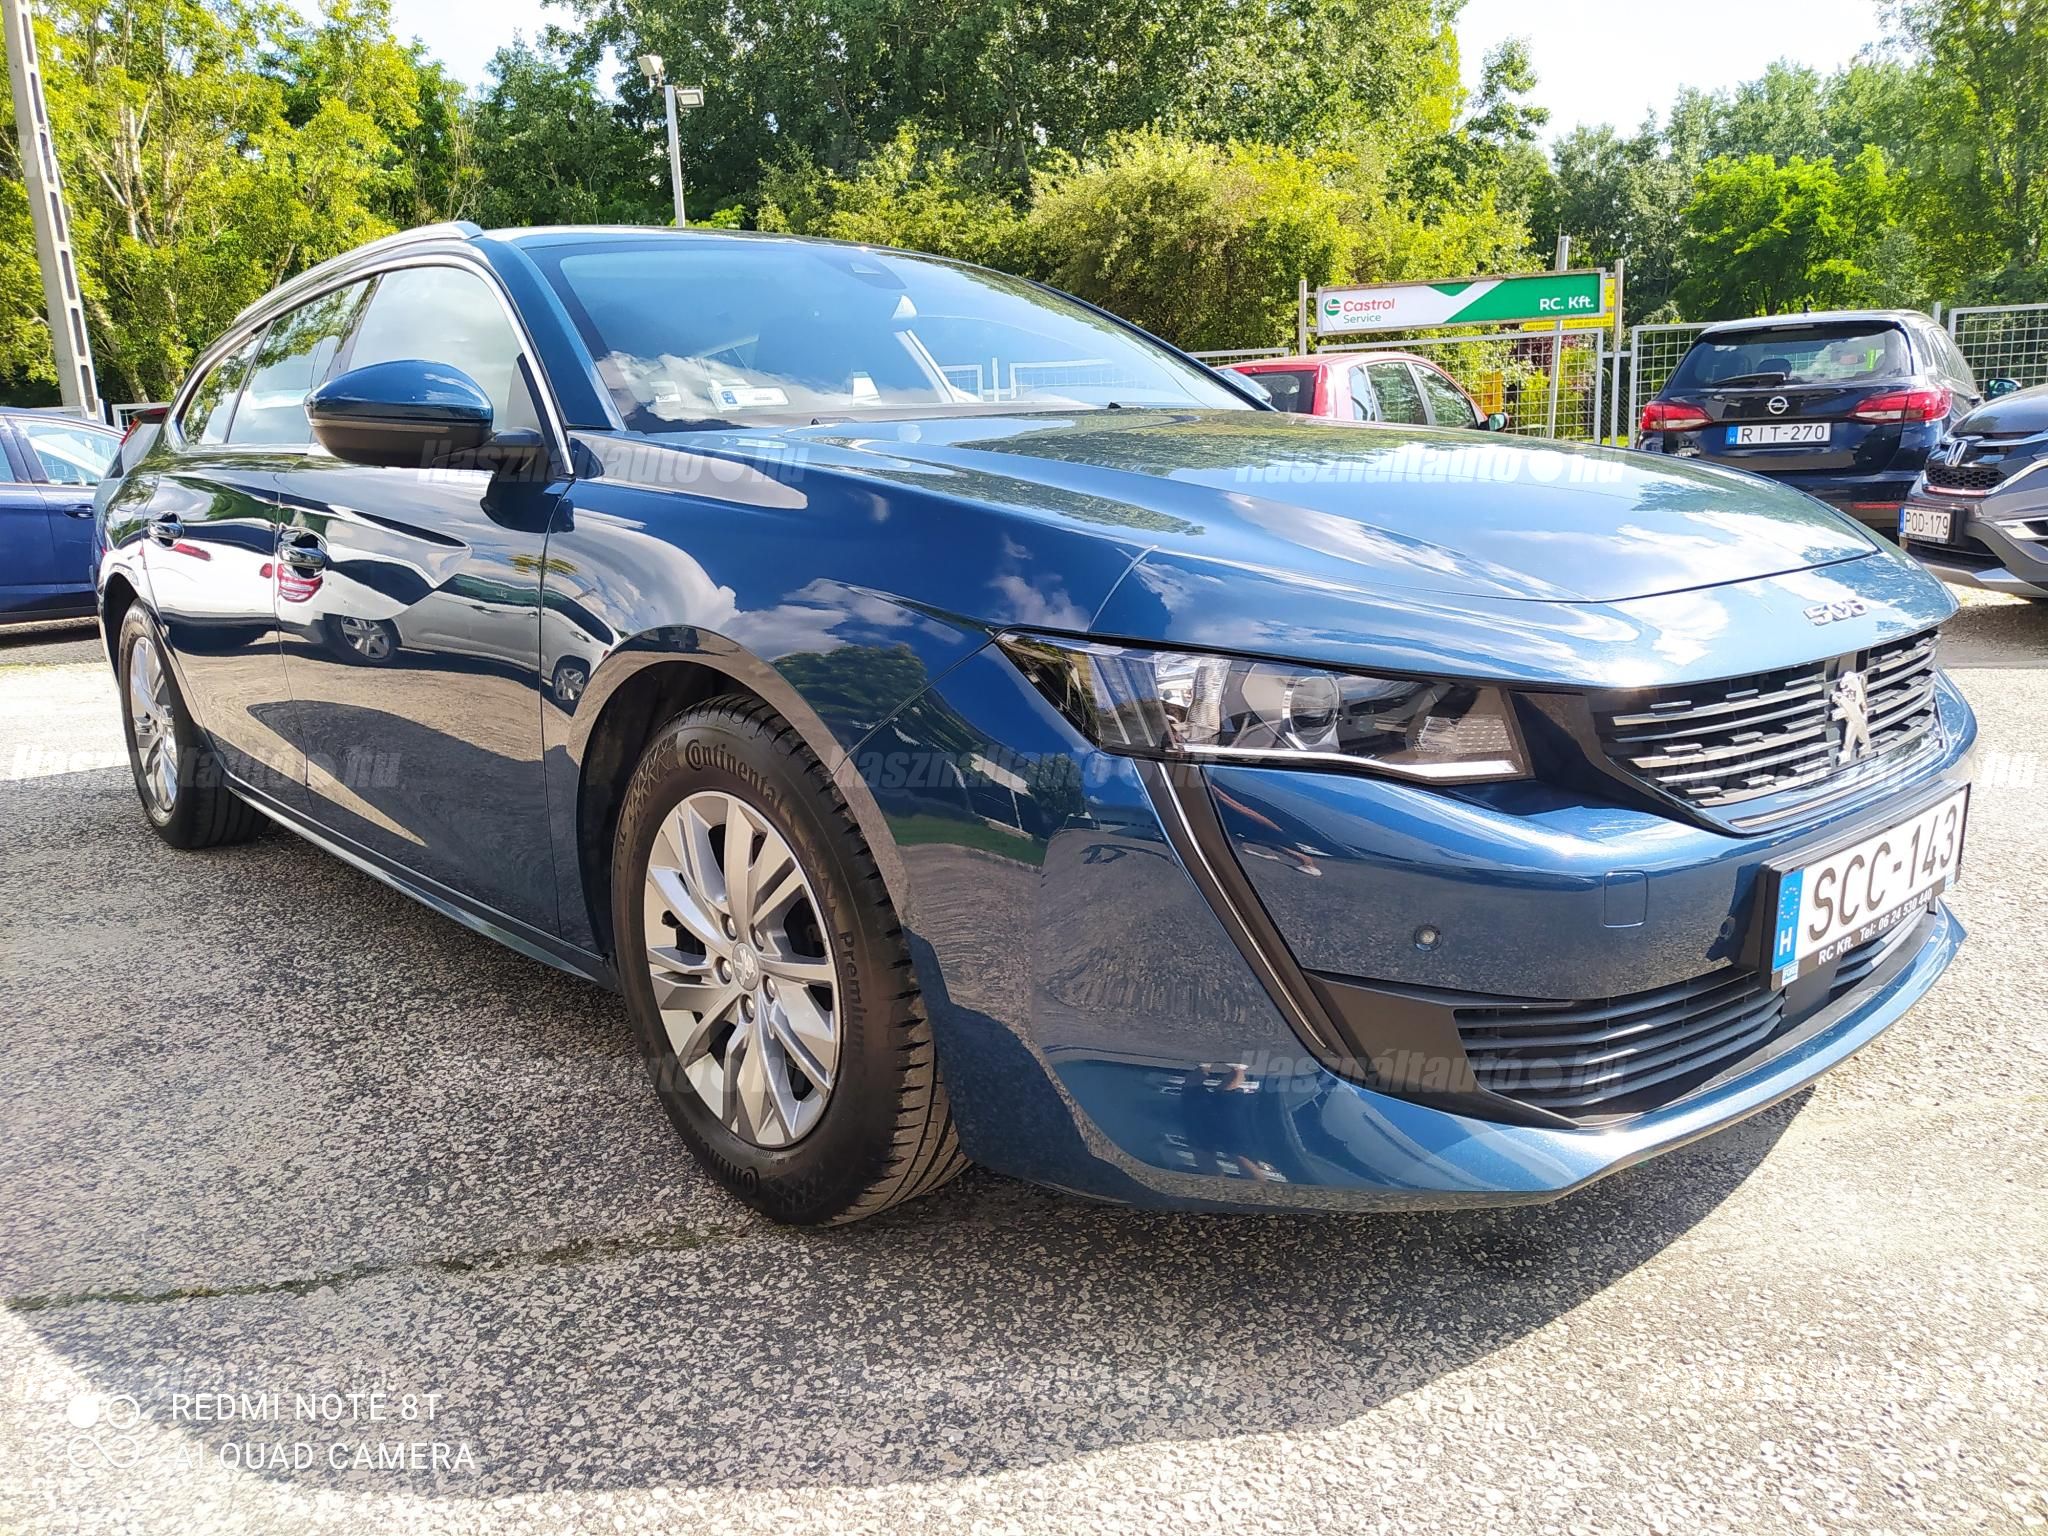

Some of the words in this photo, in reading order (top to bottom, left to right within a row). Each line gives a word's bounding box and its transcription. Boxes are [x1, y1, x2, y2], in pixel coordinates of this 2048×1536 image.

[1343, 298, 1395, 312] Castrol
[1539, 297, 1565, 311] RC.
[1568, 295, 1594, 309] Kft.
[1343, 314, 1382, 324] Service
[1741, 425, 1825, 442] RIT-270
[1905, 511, 1949, 536] POD-179
[1809, 805, 1957, 941] SCC-143
[1778, 926, 1793, 956] H
[1818, 947, 1834, 965] RC
[1860, 926, 1876, 942] Tel:
[1878, 917, 1890, 931] 06
[1890, 908, 1902, 924] 24
